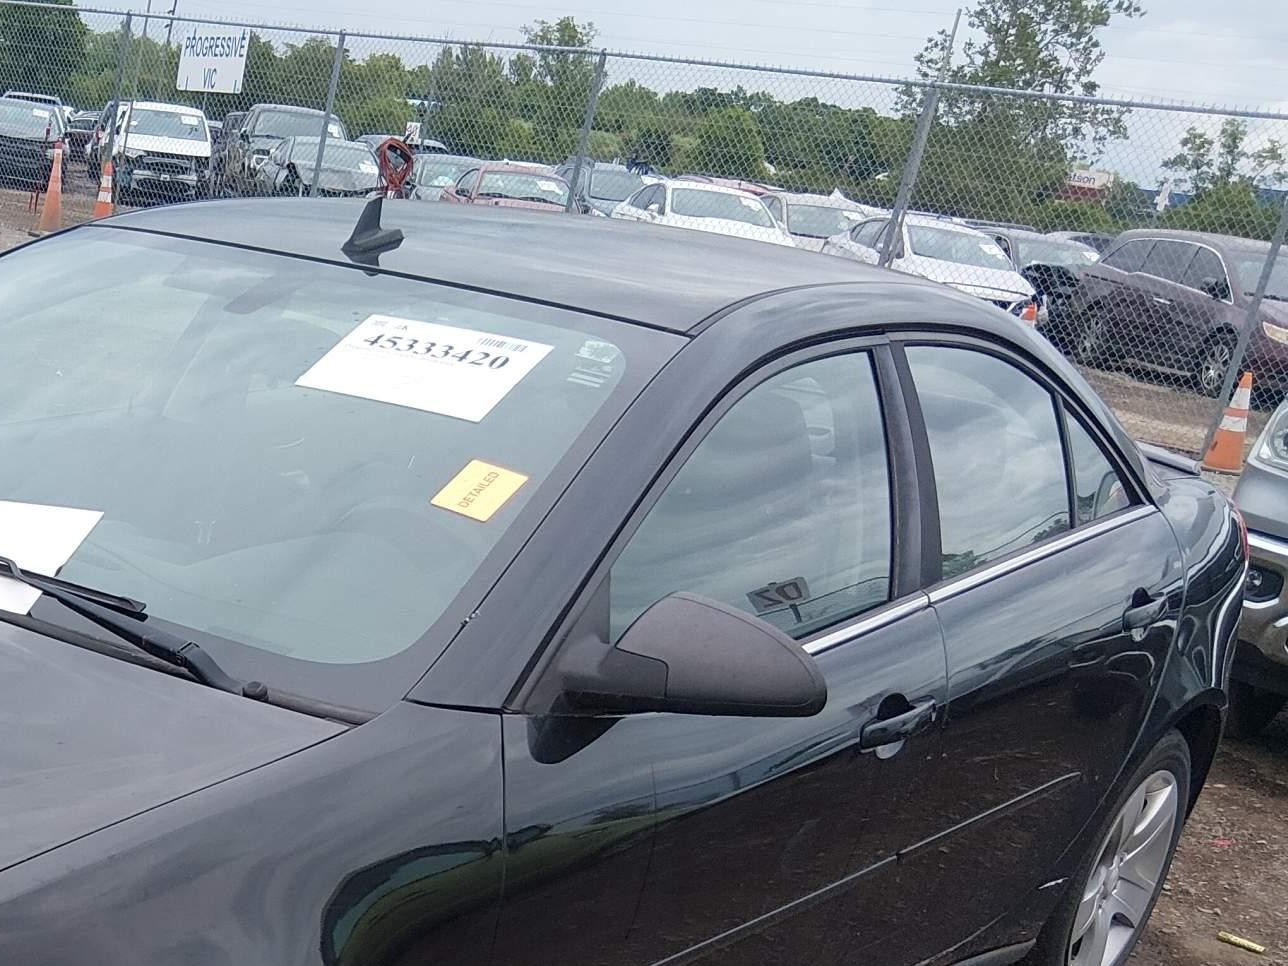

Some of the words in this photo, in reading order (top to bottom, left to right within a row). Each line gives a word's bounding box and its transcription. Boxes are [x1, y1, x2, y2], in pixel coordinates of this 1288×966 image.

[184, 36, 246, 57] PROGRESSIVE
[203, 67, 217, 89] VIC
[363, 334, 510, 369] 45333420
[458, 471, 500, 508] DETAILED
